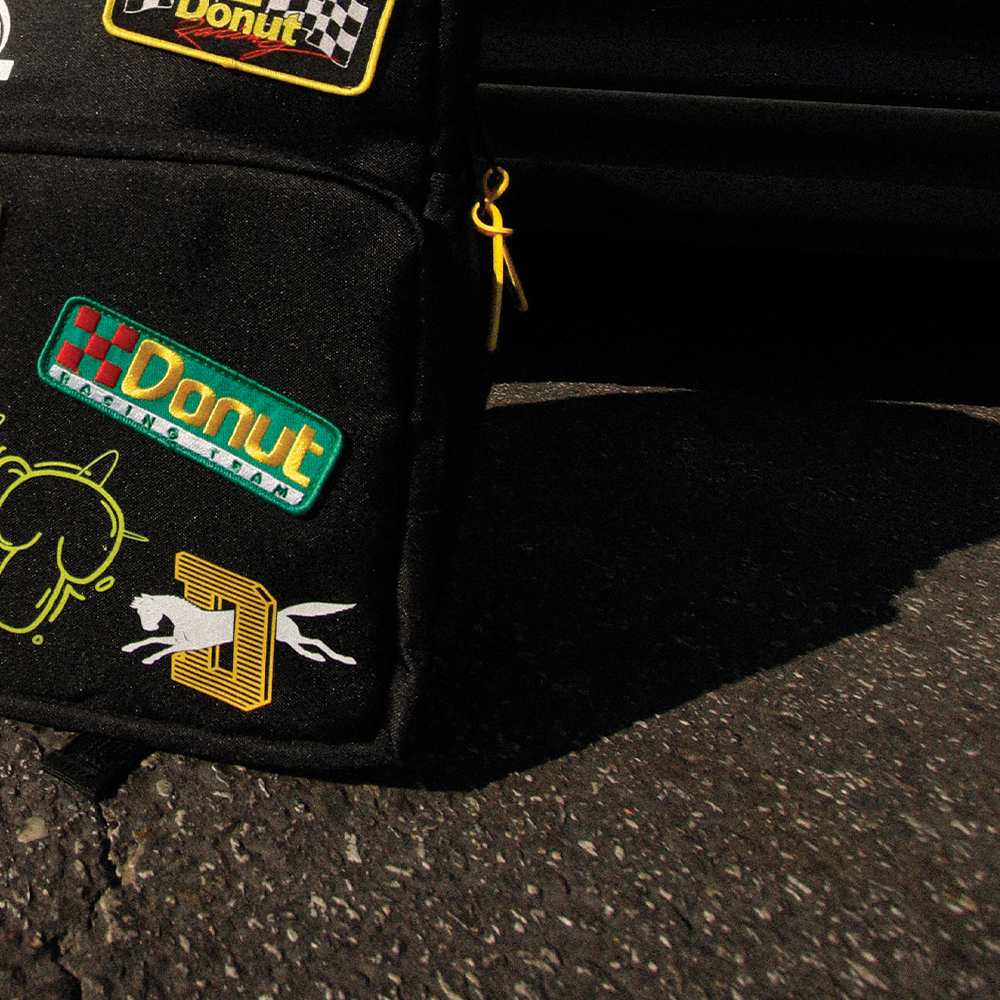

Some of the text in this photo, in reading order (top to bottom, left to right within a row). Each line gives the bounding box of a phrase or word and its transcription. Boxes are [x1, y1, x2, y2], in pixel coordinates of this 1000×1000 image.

[59, 371, 288, 499] RACING TEAM
[120, 338, 325, 489] Donut
